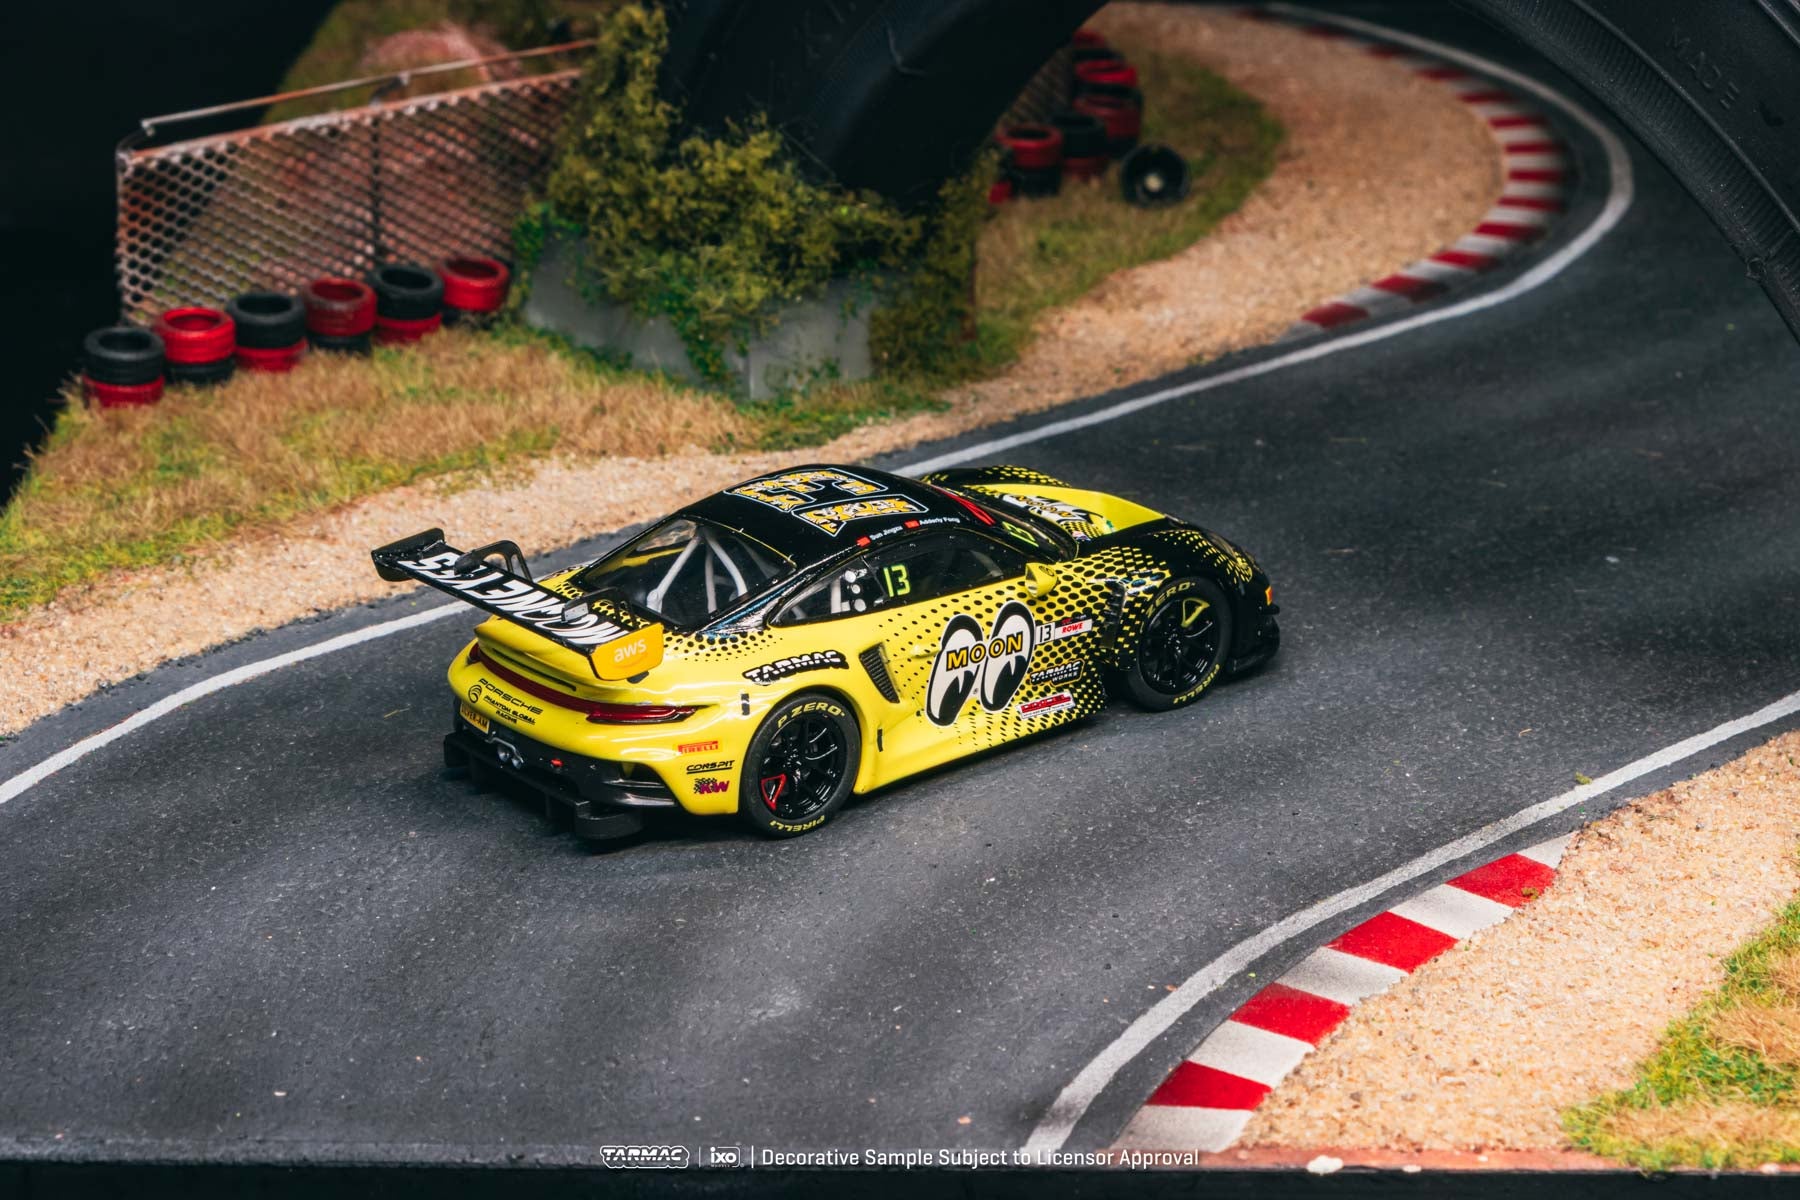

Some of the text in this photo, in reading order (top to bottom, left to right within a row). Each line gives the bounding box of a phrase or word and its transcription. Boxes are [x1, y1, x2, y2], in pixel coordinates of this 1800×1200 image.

[883, 564, 911, 598] 13
[1040, 625, 1052, 643] 13
[613, 638, 647, 663] aws
[946, 631, 1023, 671] MOON
[743, 649, 844, 683] TARMAC
[1030, 660, 1081, 683] TARMAC
[1052, 671, 1077, 682] WORKS
[478, 678, 544, 715] PORSCHE
[1173, 664, 1221, 704] PIRELLI
[484, 695, 536, 724] PHANTOM GLOBAL
[496, 710, 517, 724] RACING
[777, 702, 842, 728] P ZERO
[678, 741, 719, 754] PIRELLI
[700, 780, 730, 795] KW
[769, 815, 826, 832] PIRELLI
